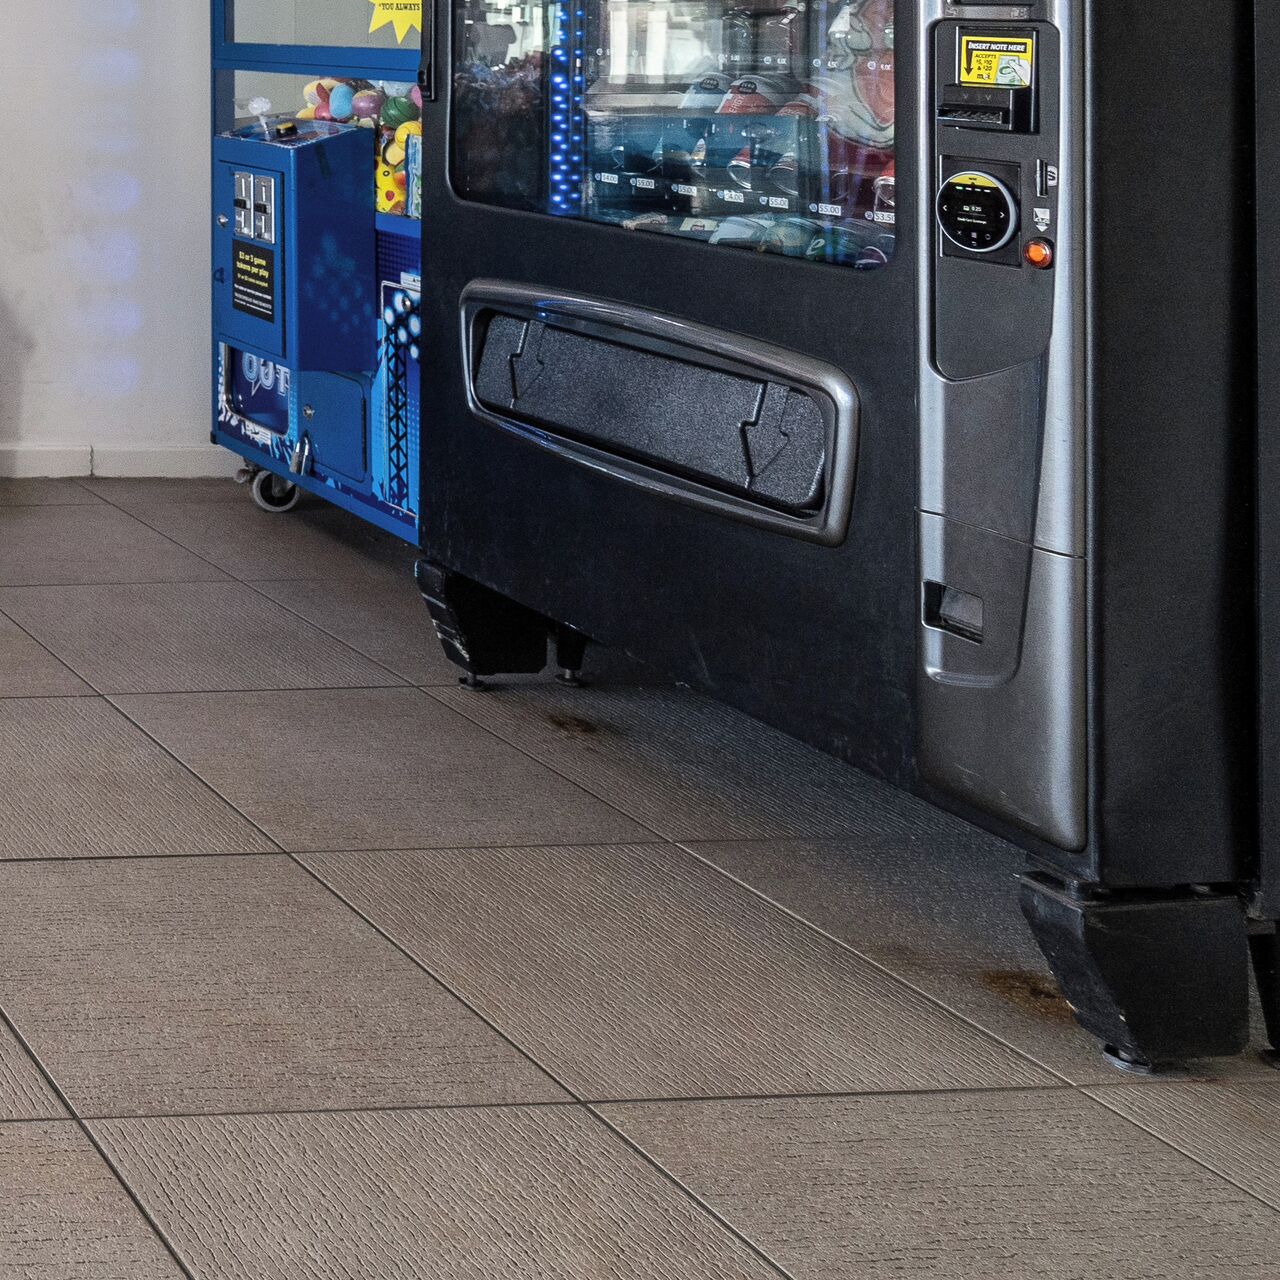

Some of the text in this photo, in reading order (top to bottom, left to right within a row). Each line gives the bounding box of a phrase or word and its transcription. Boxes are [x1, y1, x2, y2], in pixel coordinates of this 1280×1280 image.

[395, 3, 420, 11] ALWAYS
[968, 42, 990, 50] INSERT
[990, 43, 1009, 51] NOTE
